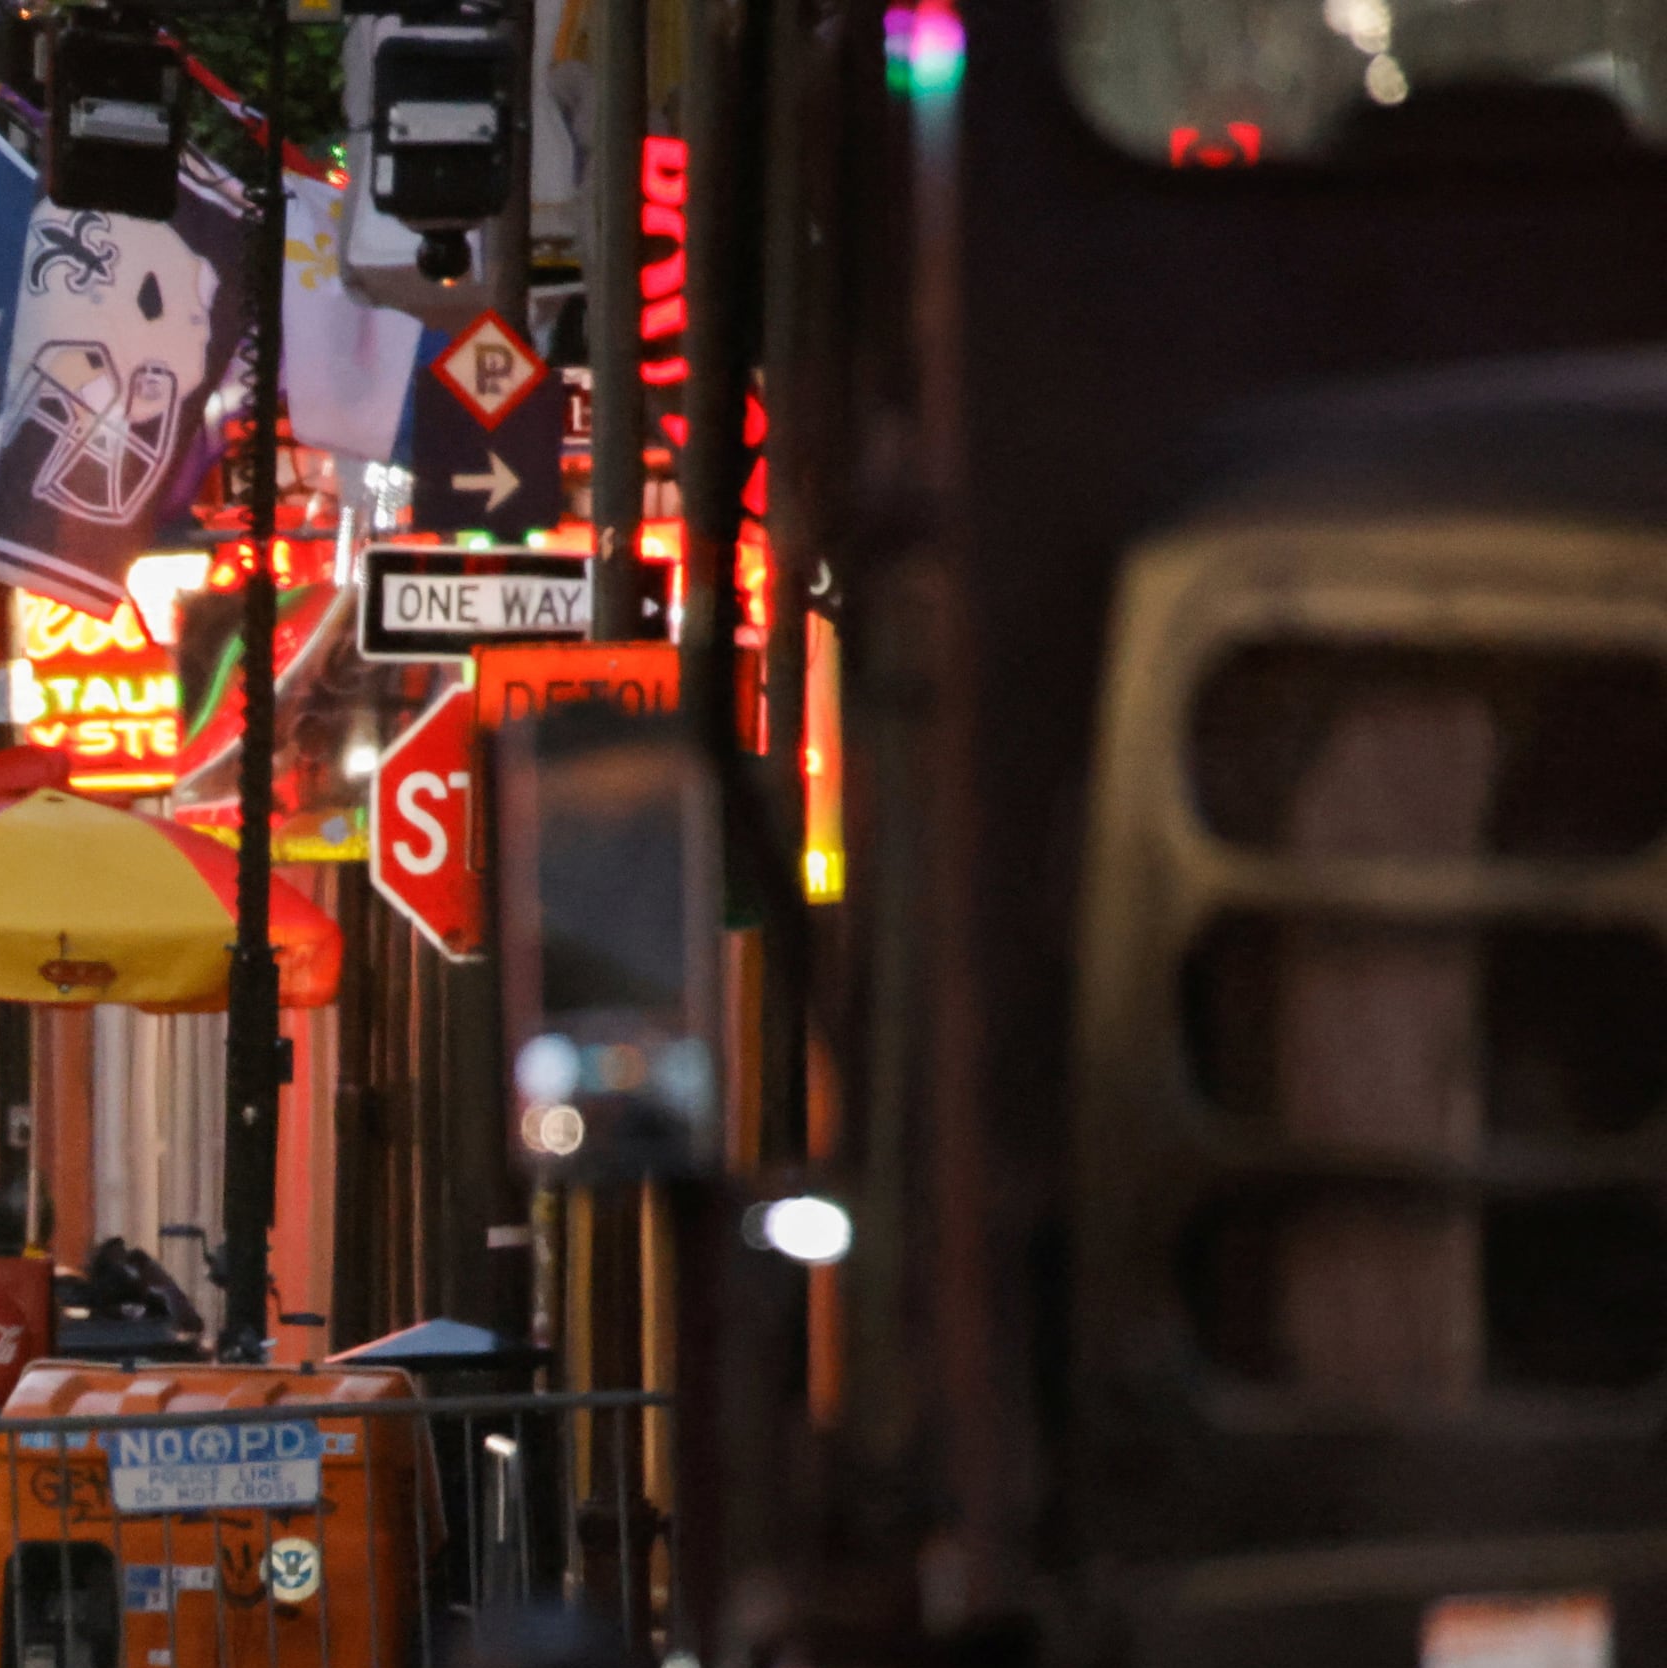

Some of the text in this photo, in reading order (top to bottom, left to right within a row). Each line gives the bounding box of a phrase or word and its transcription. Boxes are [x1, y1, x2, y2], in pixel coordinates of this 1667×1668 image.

[398, 583, 582, 627] ONE WAY
[392, 770, 470, 875] S
